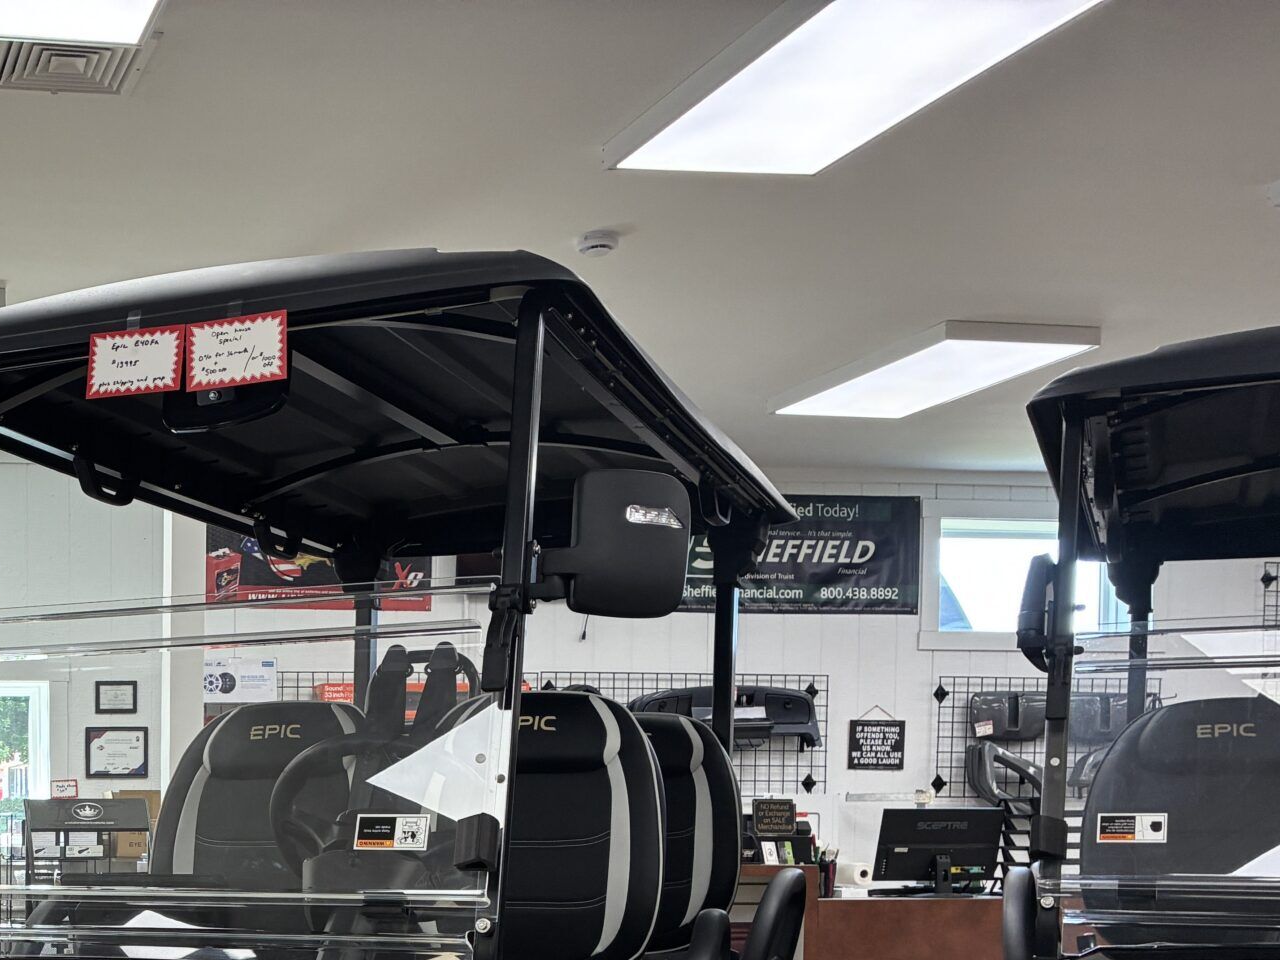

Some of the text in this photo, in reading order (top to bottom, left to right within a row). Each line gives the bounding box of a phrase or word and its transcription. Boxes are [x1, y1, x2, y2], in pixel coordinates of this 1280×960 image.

[111, 343, 128, 351] Epic
[816, 504, 859, 519] Today!
[744, 572, 769, 580] division
[770, 572, 776, 580] of
[837, 567, 867, 575] Financial
[820, 587, 899, 600] 800.438.8892
[519, 715, 556, 731] PIC
[250, 724, 301, 739] EPIC
[1196, 723, 1257, 738] EPIC
[916, 821, 968, 831] SCEPTRE
